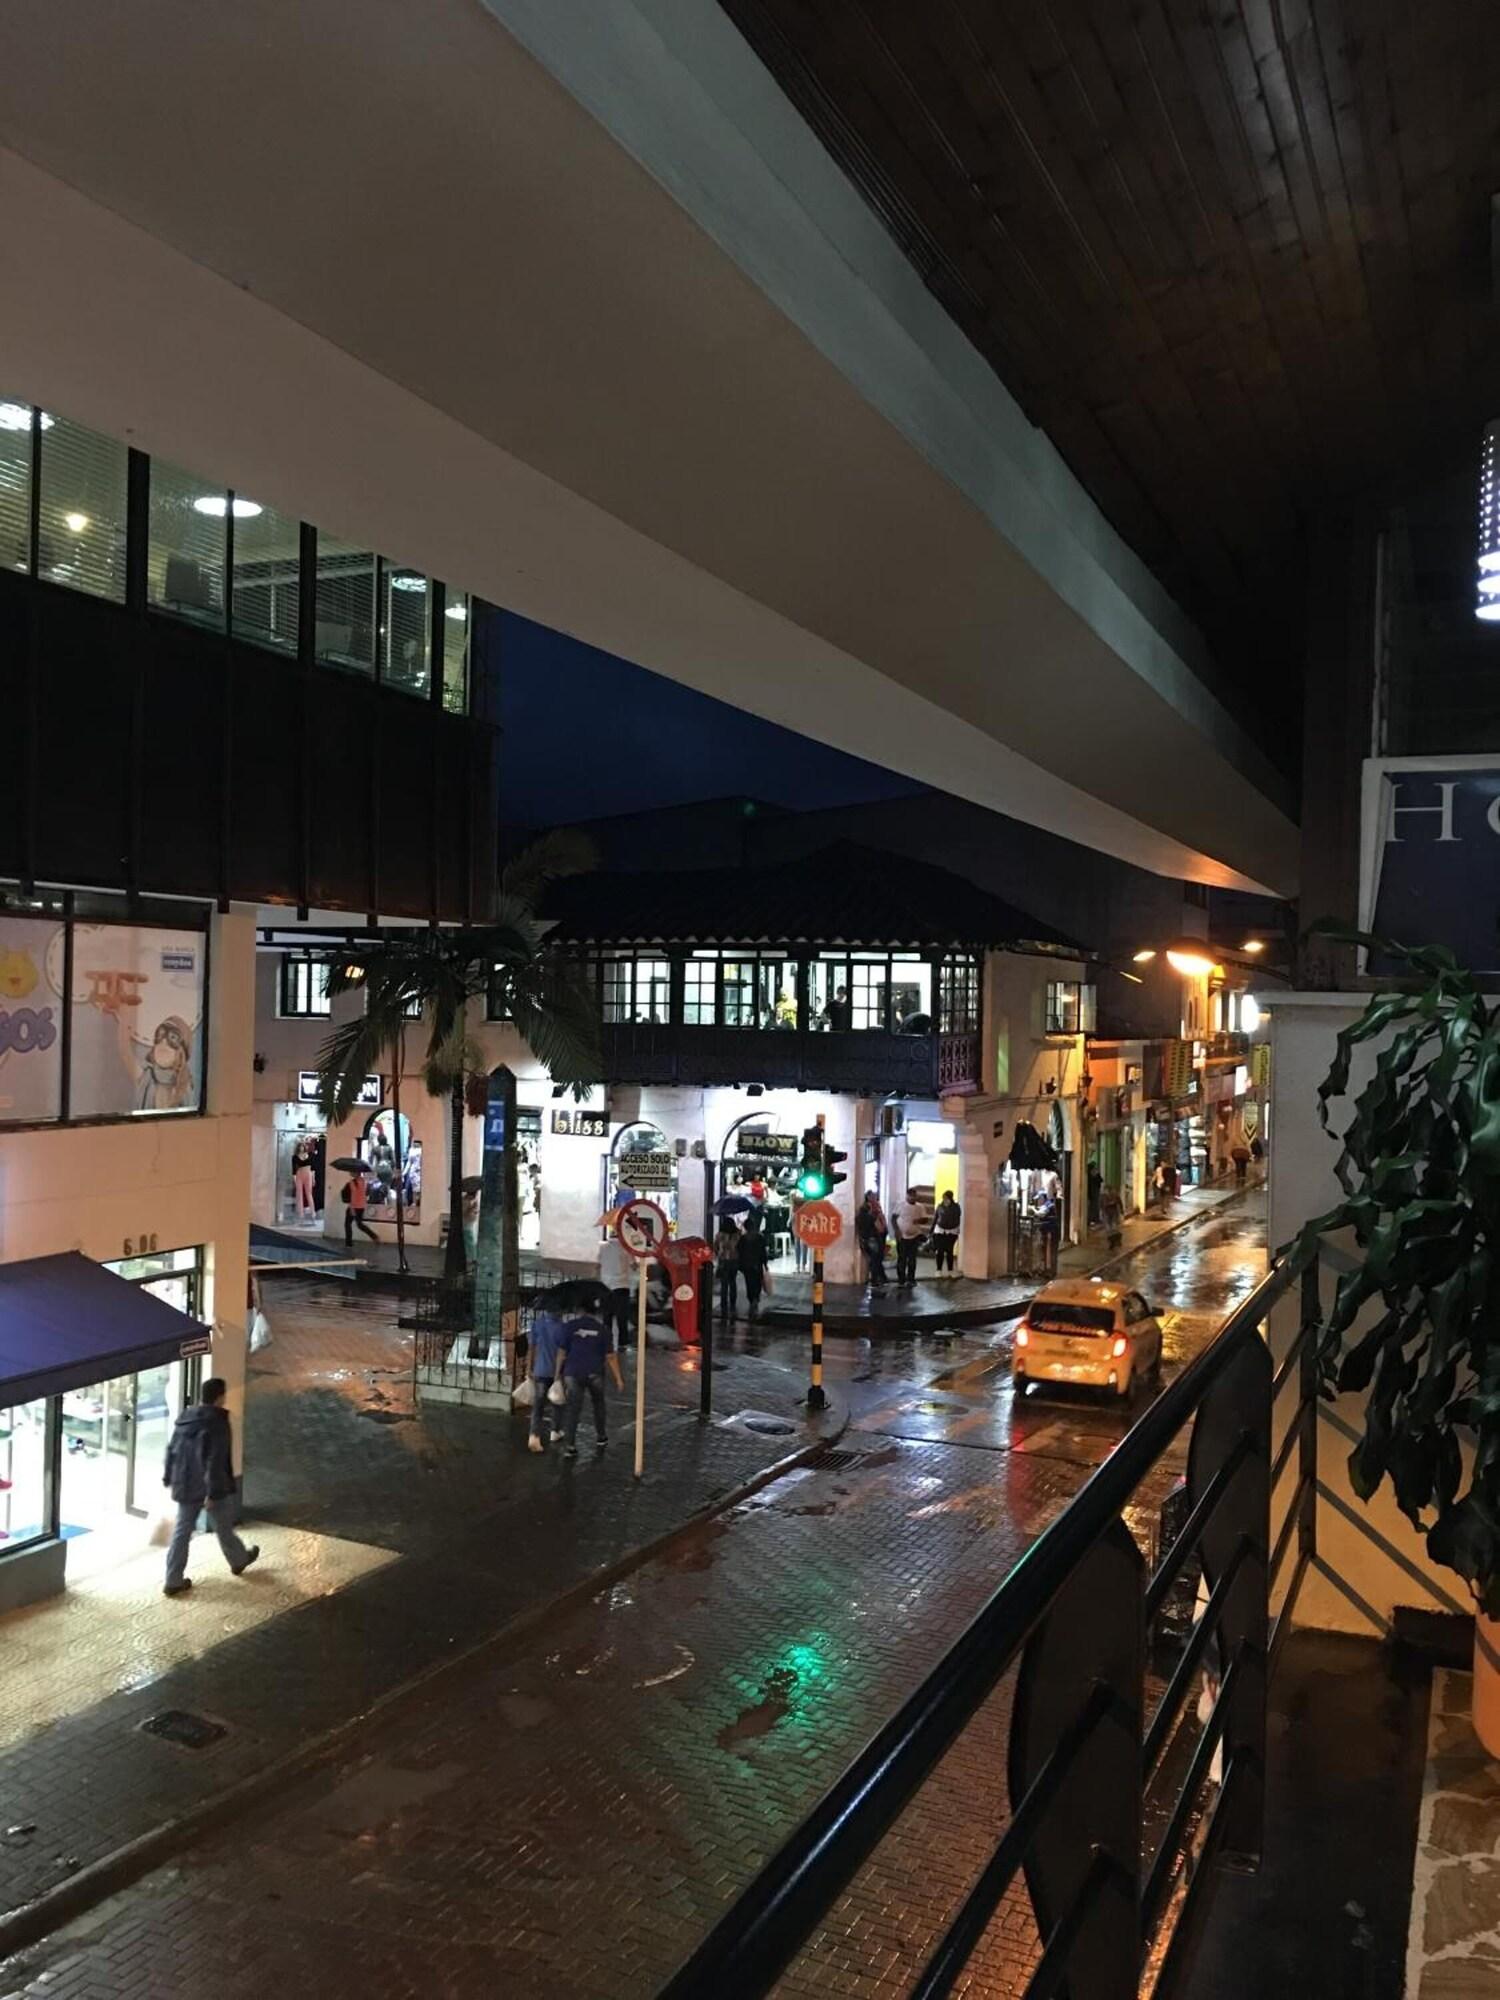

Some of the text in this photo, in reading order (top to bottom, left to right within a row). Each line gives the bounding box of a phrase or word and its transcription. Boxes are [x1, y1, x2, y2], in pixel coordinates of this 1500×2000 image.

[555, 1109, 604, 1136] bliss
[742, 1135, 794, 1149] BLOW
[621, 1154, 670, 1164] ACCESO SOLO
[800, 1214, 837, 1234] PARE
